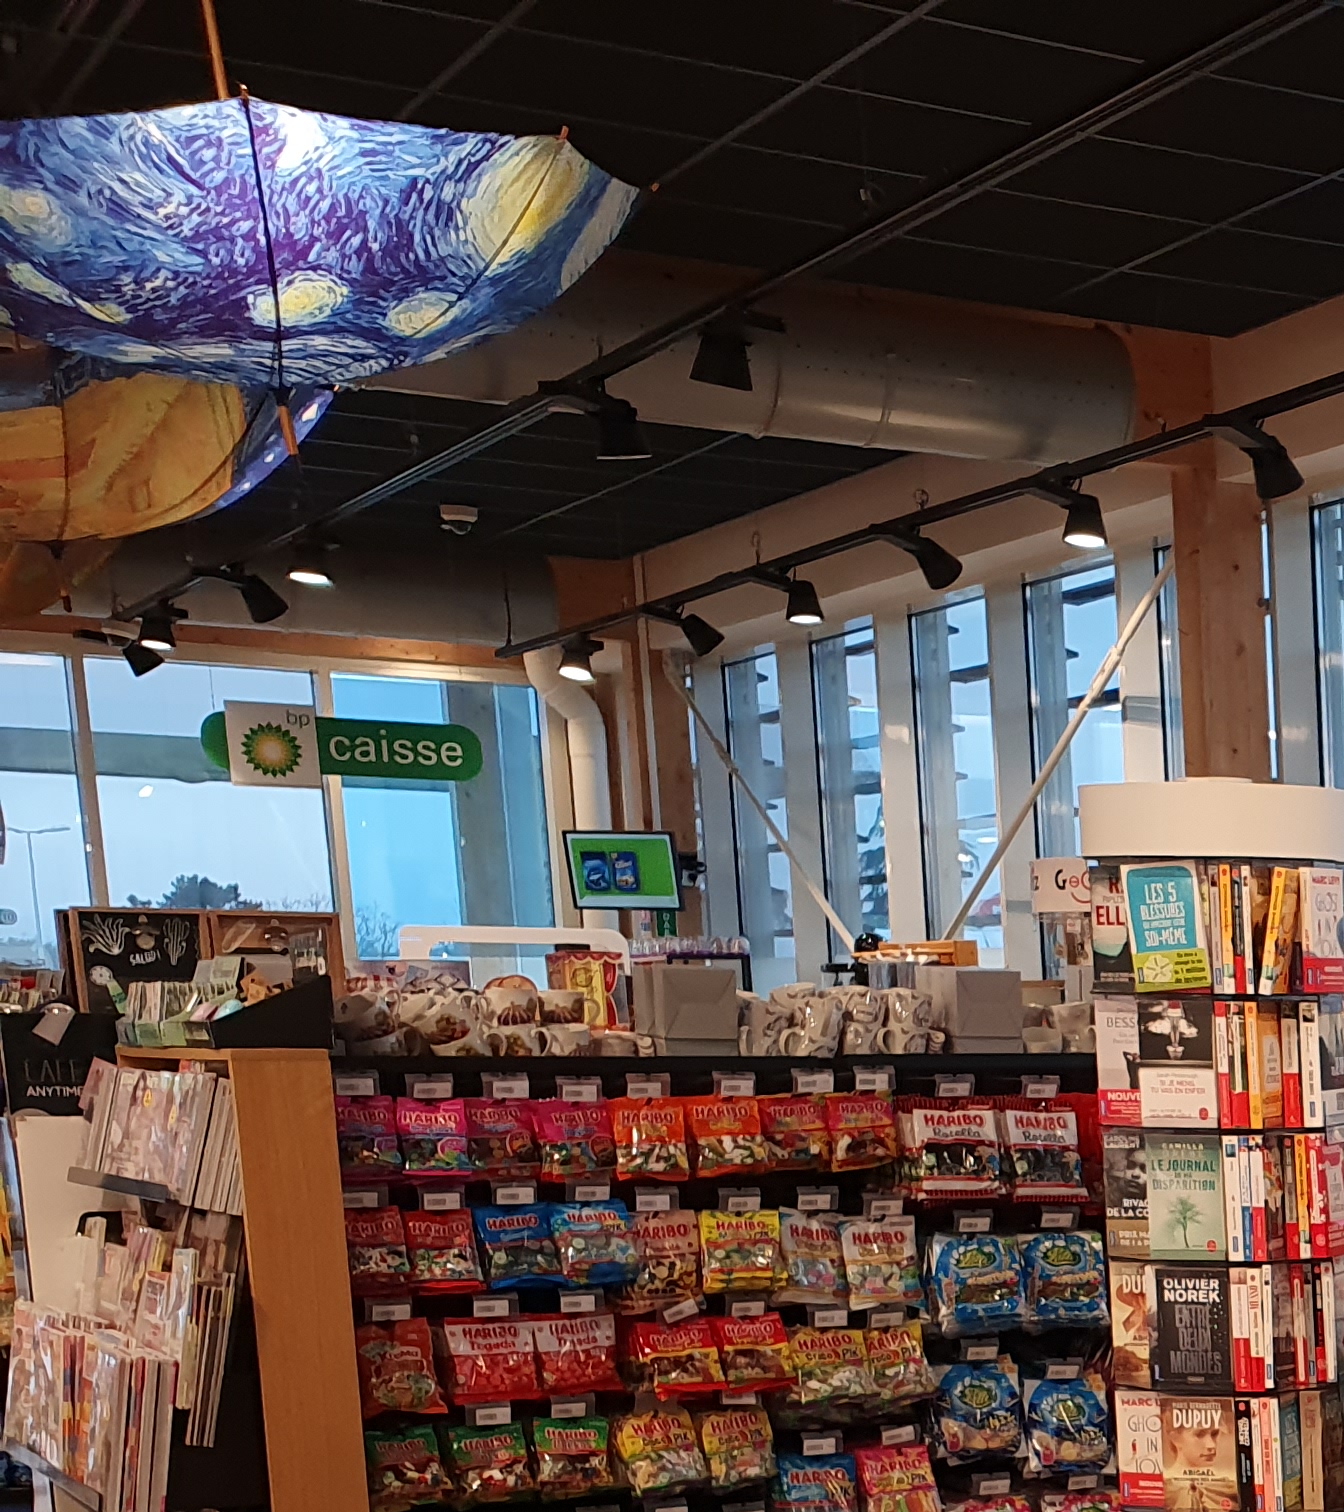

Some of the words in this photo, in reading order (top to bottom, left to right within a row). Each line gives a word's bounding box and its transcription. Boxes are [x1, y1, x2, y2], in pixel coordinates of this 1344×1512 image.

[285, 709, 311, 727] bp
[328, 730, 464, 767] caisse
[1145, 883, 1164, 903] LES
[1168, 882, 1177, 902] 5
[924, 1114, 984, 1128] HARIBO
[1014, 1115, 1067, 1130] HARIBO
[486, 1215, 538, 1229] HARIBO
[1163, 1278, 1220, 1290] OLIVIER
[1163, 1290, 1220, 1303] NOREK
[462, 1326, 518, 1339] HARIBO
[798, 1335, 853, 1351] HARIBO
[1172, 1409, 1221, 1430] DUPUY
[789, 1469, 847, 1485] HARIBO
